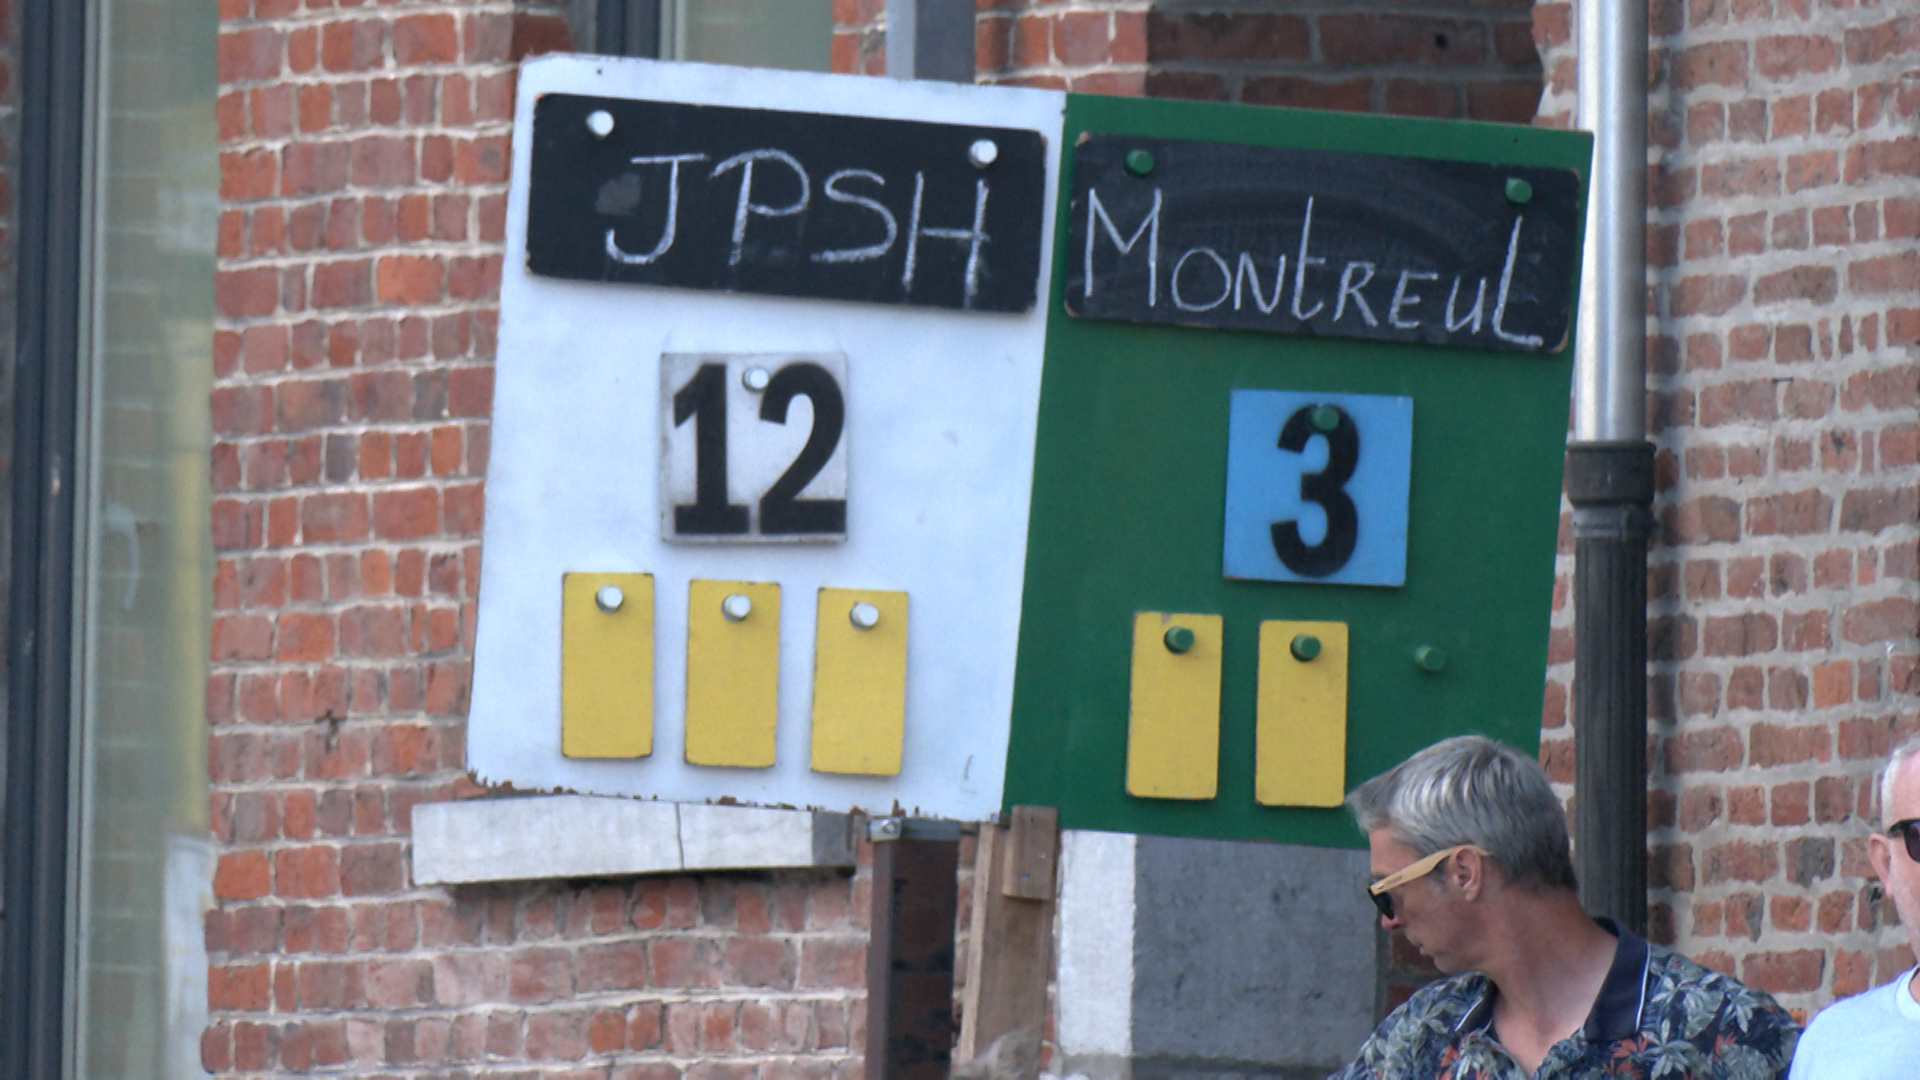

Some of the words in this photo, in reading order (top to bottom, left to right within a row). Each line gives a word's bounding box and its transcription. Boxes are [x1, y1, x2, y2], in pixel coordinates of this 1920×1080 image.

[605, 148, 990, 307] JPSH
[673, 362, 847, 535] 12
[1270, 403, 1359, 578] 3
